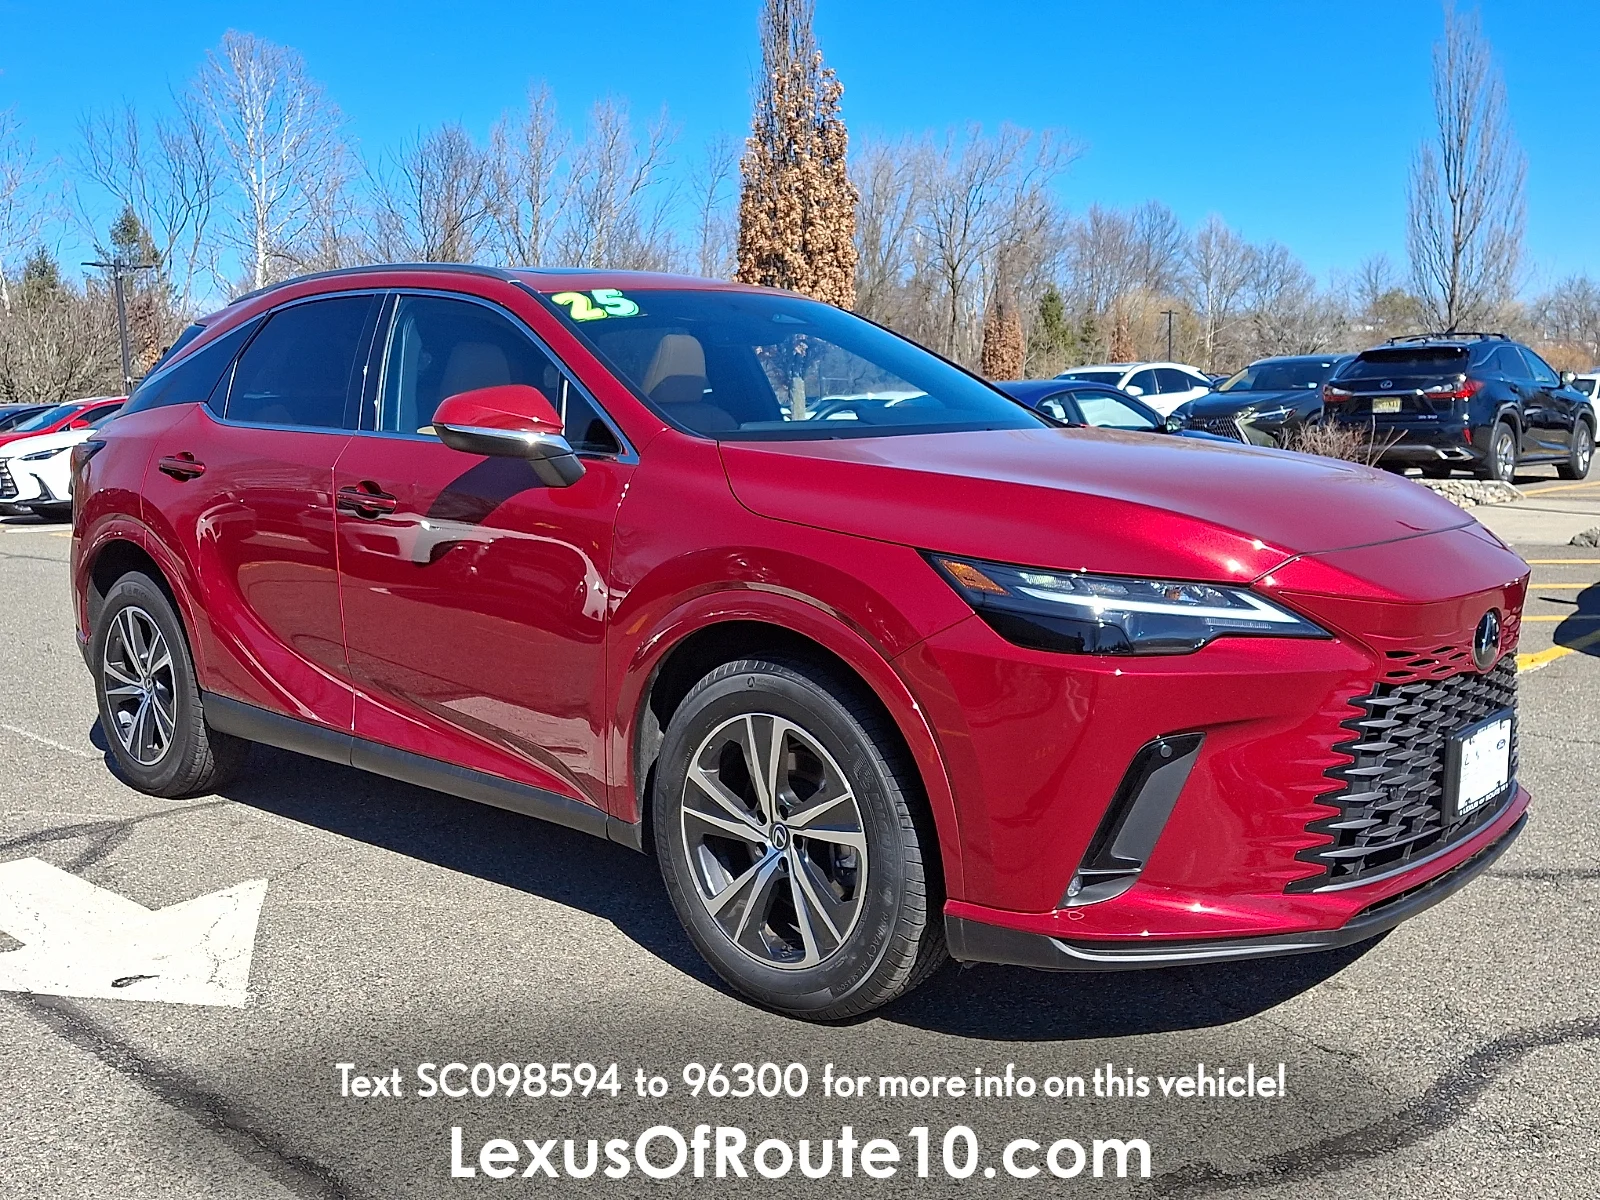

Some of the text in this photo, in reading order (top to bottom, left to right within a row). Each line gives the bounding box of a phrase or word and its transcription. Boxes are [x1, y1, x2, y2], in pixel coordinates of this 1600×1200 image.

[550, 288, 640, 322] 25
[866, 911, 889, 961] PRIMACY
[836, 972, 860, 992] SEASON
